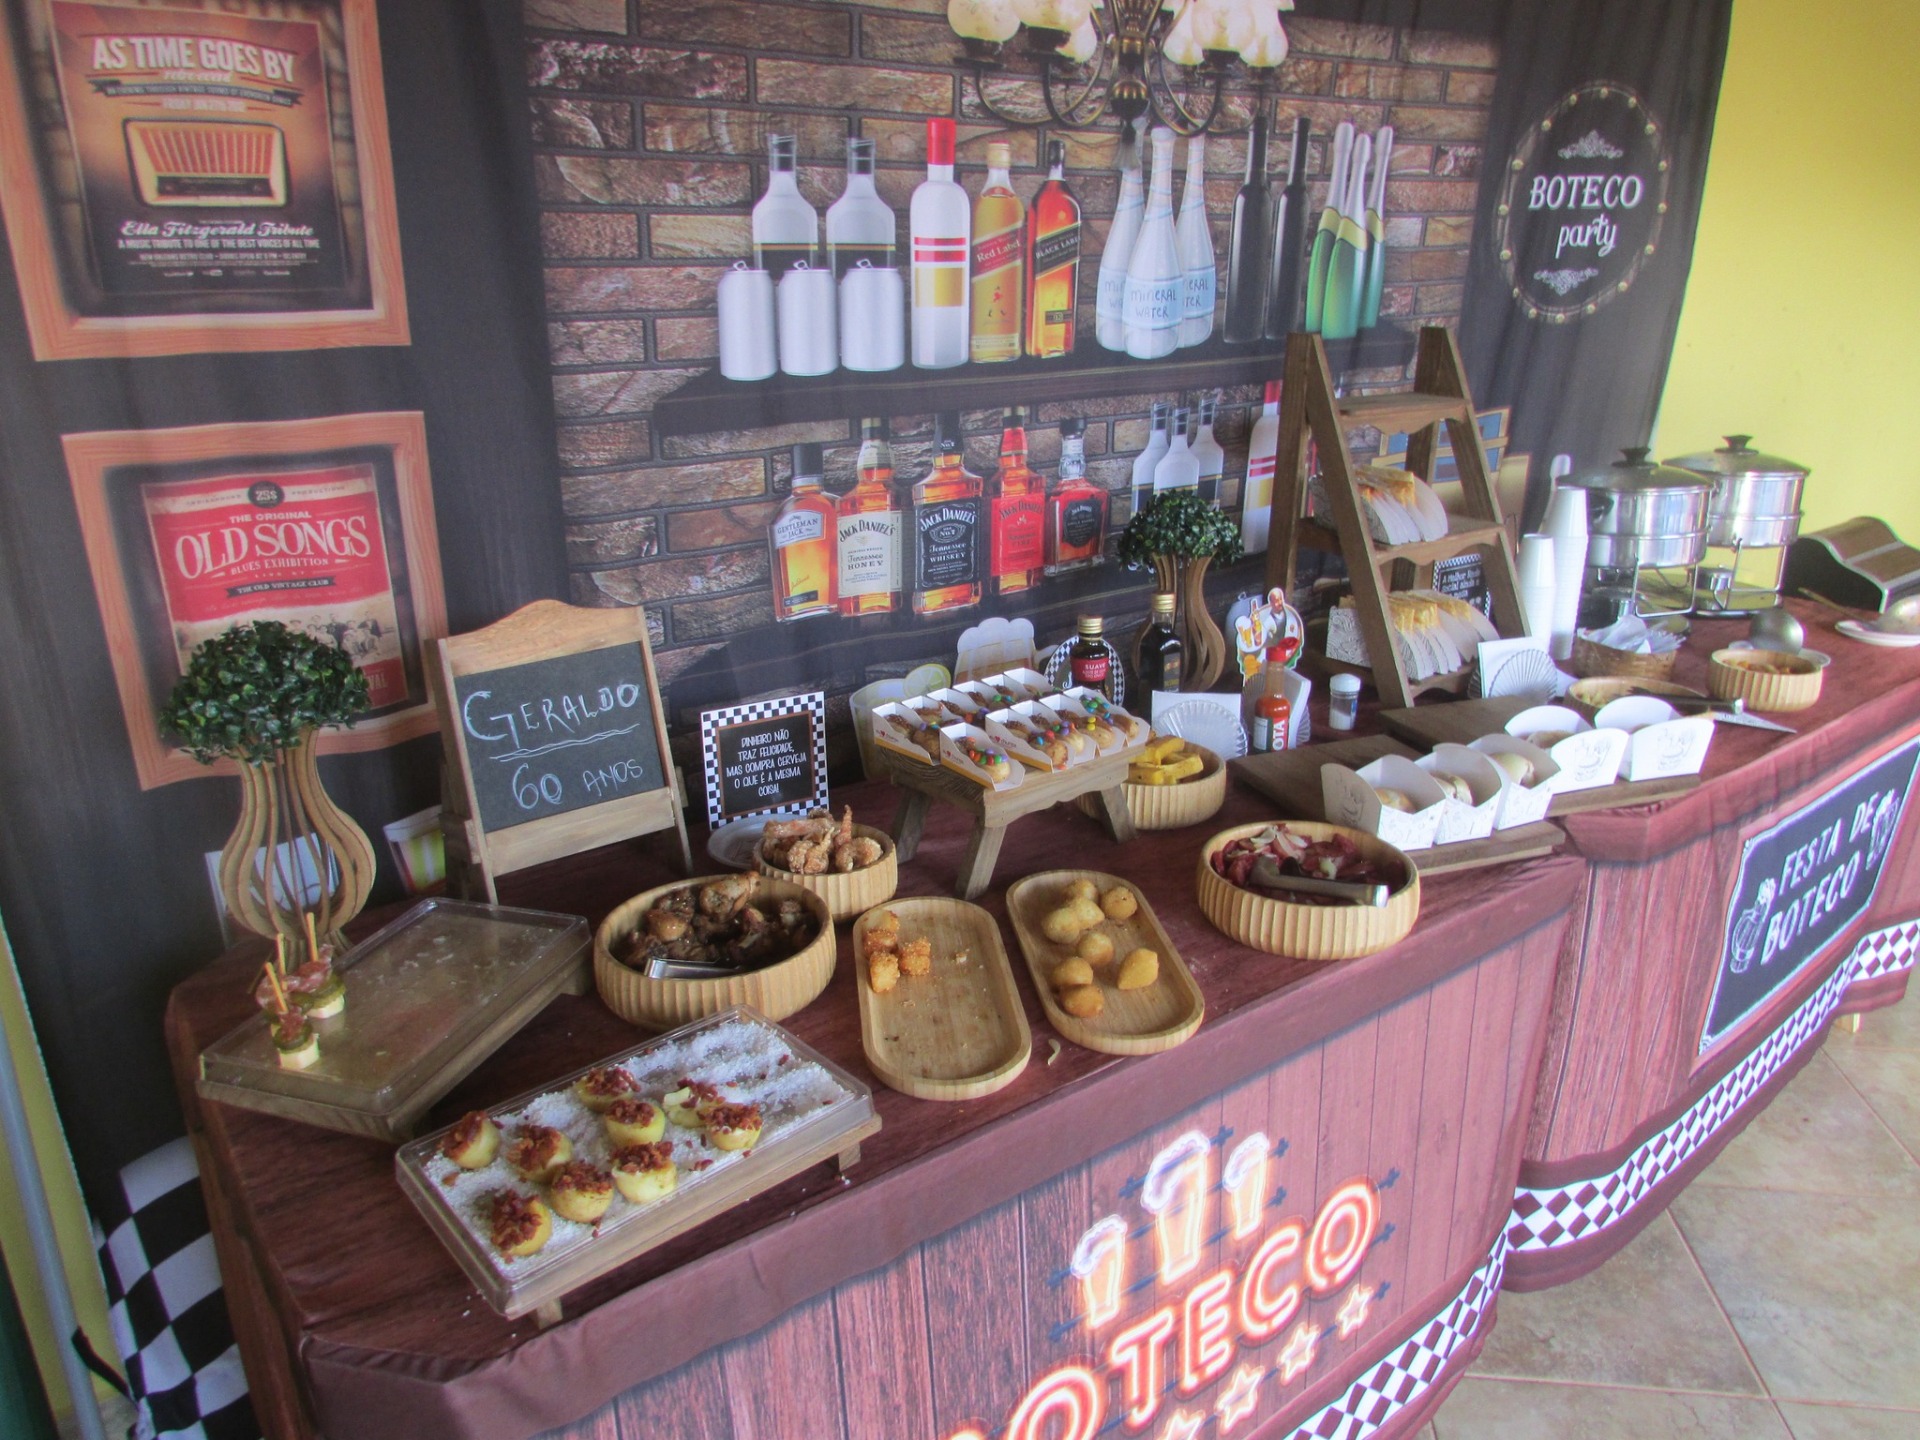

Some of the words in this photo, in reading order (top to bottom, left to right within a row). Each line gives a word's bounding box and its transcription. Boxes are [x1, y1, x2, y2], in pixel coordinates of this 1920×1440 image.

[92, 37, 127, 70] AS
[130, 38, 196, 69] TIME
[199, 39, 261, 75] GOES
[263, 48, 294, 82] BY
[1528, 175, 1646, 211] BOTECO
[121, 220, 158, 236] Ella
[162, 220, 255, 239] Fitzgerald
[257, 221, 314, 237] Tribute
[1555, 213, 1617, 259] party
[976, 249, 996, 262] Red
[997, 239, 1021, 255] Label
[1035, 245, 1060, 260] BLACK
[229, 513, 252, 525] THE
[256, 511, 312, 522] ORIGINAL
[776, 518, 819, 535] GENTLEMAN
[920, 512, 943, 532] JACK
[942, 507, 977, 525] DANIEL'S
[788, 528, 804, 539] JACK
[839, 523, 858, 543] JACK
[858, 519, 896, 537] DANIEL'S
[175, 527, 249, 580] OLD
[253, 516, 370, 558] SONGS
[930, 552, 966, 563] WHISKEY
[231, 560, 262, 576] BLUES
[264, 557, 329, 570] EXHIBITION
[848, 560, 884, 570] HONEY
[253, 583, 270, 592] OLD
[271, 580, 306, 590] VINTAGE
[307, 579, 329, 587] CLUB
[1084, 662, 1106, 670] SUAVE
[464, 684, 639, 748] GERALDO
[741, 733, 772, 748] DINHEIRO
[774, 728, 790, 741] NÃO
[1272, 720, 1285, 751] OTA
[738, 748, 757, 762] TRAZ
[759, 741, 795, 758] FELICIDADE,
[726, 764, 743, 777] MAS
[745, 759, 775, 774] COMPRA
[777, 752, 807, 767] CERVEJA
[512, 763, 563, 809] 60
[583, 759, 643, 797] ANOS
[734, 778, 740, 789] O
[743, 774, 759, 787] QUE
[760, 772, 765, 785] É
[768, 773, 773, 782] A
[774, 766, 801, 780] MESMA
[758, 783, 780, 797] COISA!
[1779, 817, 1844, 896] FESTA
[1849, 792, 1879, 843] DE
[1760, 850, 1862, 966] BOTECO
[948, 1178, 1380, 1440] OTECO
